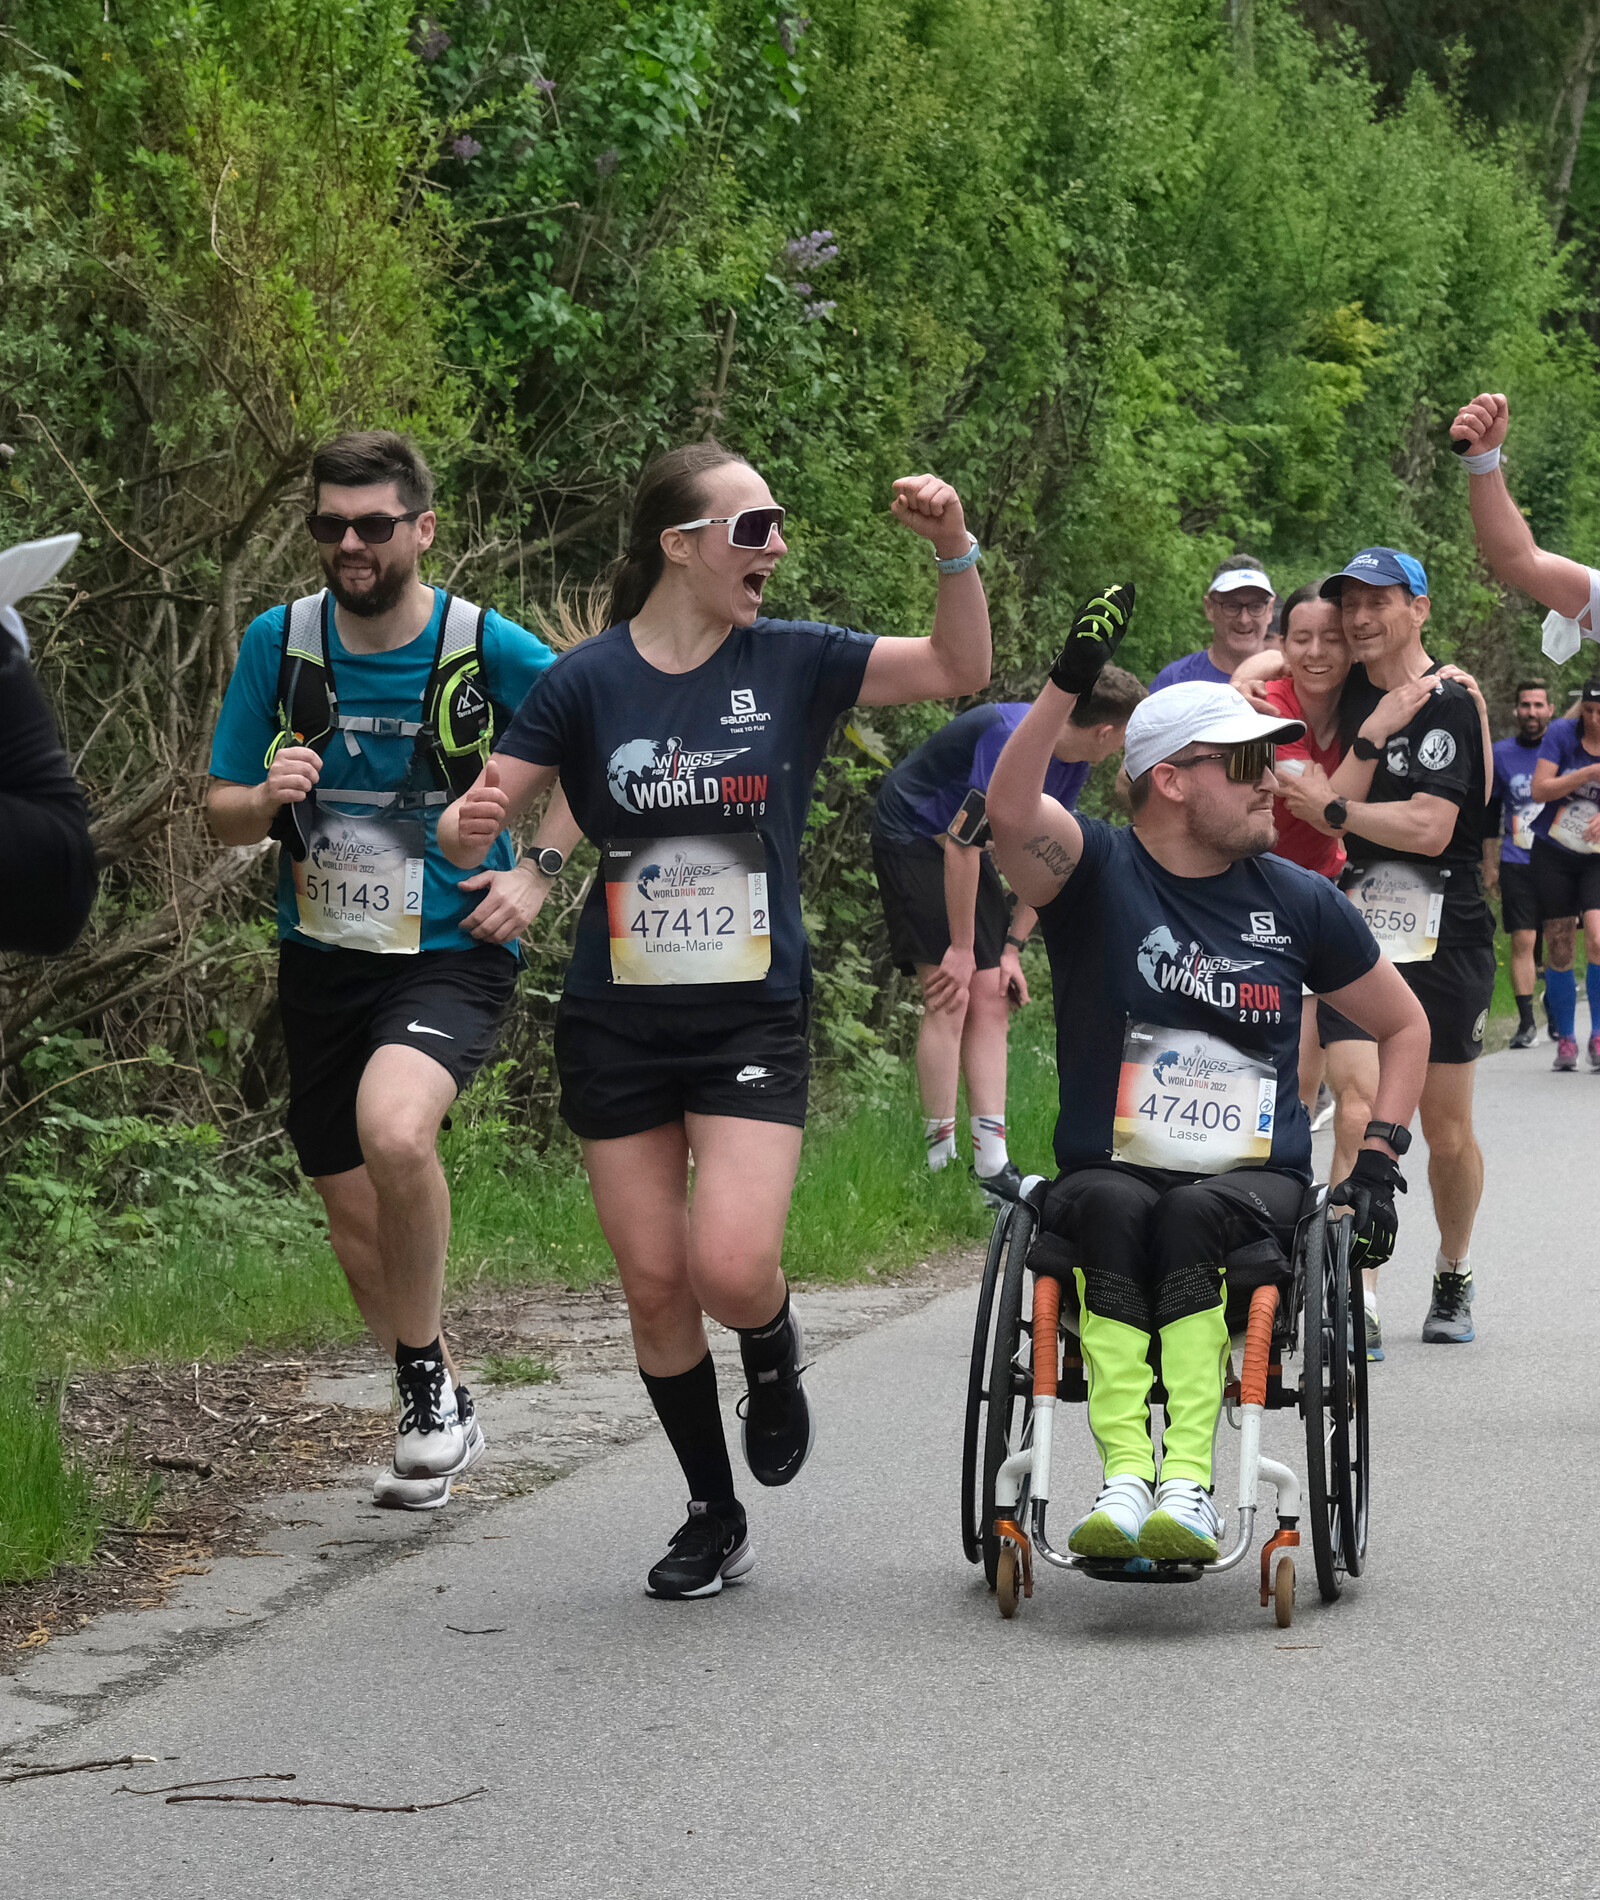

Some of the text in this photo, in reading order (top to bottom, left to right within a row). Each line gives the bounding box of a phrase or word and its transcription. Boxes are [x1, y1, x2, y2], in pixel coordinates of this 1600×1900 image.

[655, 751, 713, 768] WINGS
[663, 766, 698, 781] LIFE
[632, 774, 768, 810] WORLD RUN
[723, 801, 766, 817] 2019
[1561, 818, 1583, 834] 526
[331, 841, 374, 854] WINGS
[336, 853, 360, 863] LIFE
[322, 861, 342, 871] WORLD
[359, 865, 375, 874] 2022
[664, 863, 711, 878] WINGS
[670, 876, 698, 887] LIFE
[307, 874, 390, 912] 51143
[653, 886, 715, 898] WORLD RUN 2022
[406, 891, 419, 909] 2
[323, 906, 365, 922] Michael
[1358, 908, 1416, 933] 5559
[630, 906, 736, 938] 47412
[1429, 920, 1436, 934] 1
[645, 939, 724, 953] Linda-Marie
[1160, 963, 1281, 1011] WORLD RUN
[1239, 1010, 1281, 1024] 2019
[1182, 1056, 1228, 1071] WINGS
[1186, 1067, 1214, 1079] LIFE
[1168, 1076, 1227, 1092] WORLD RUN 2022
[1139, 1093, 1241, 1132] 47406
[1169, 1127, 1207, 1142] Lasse
